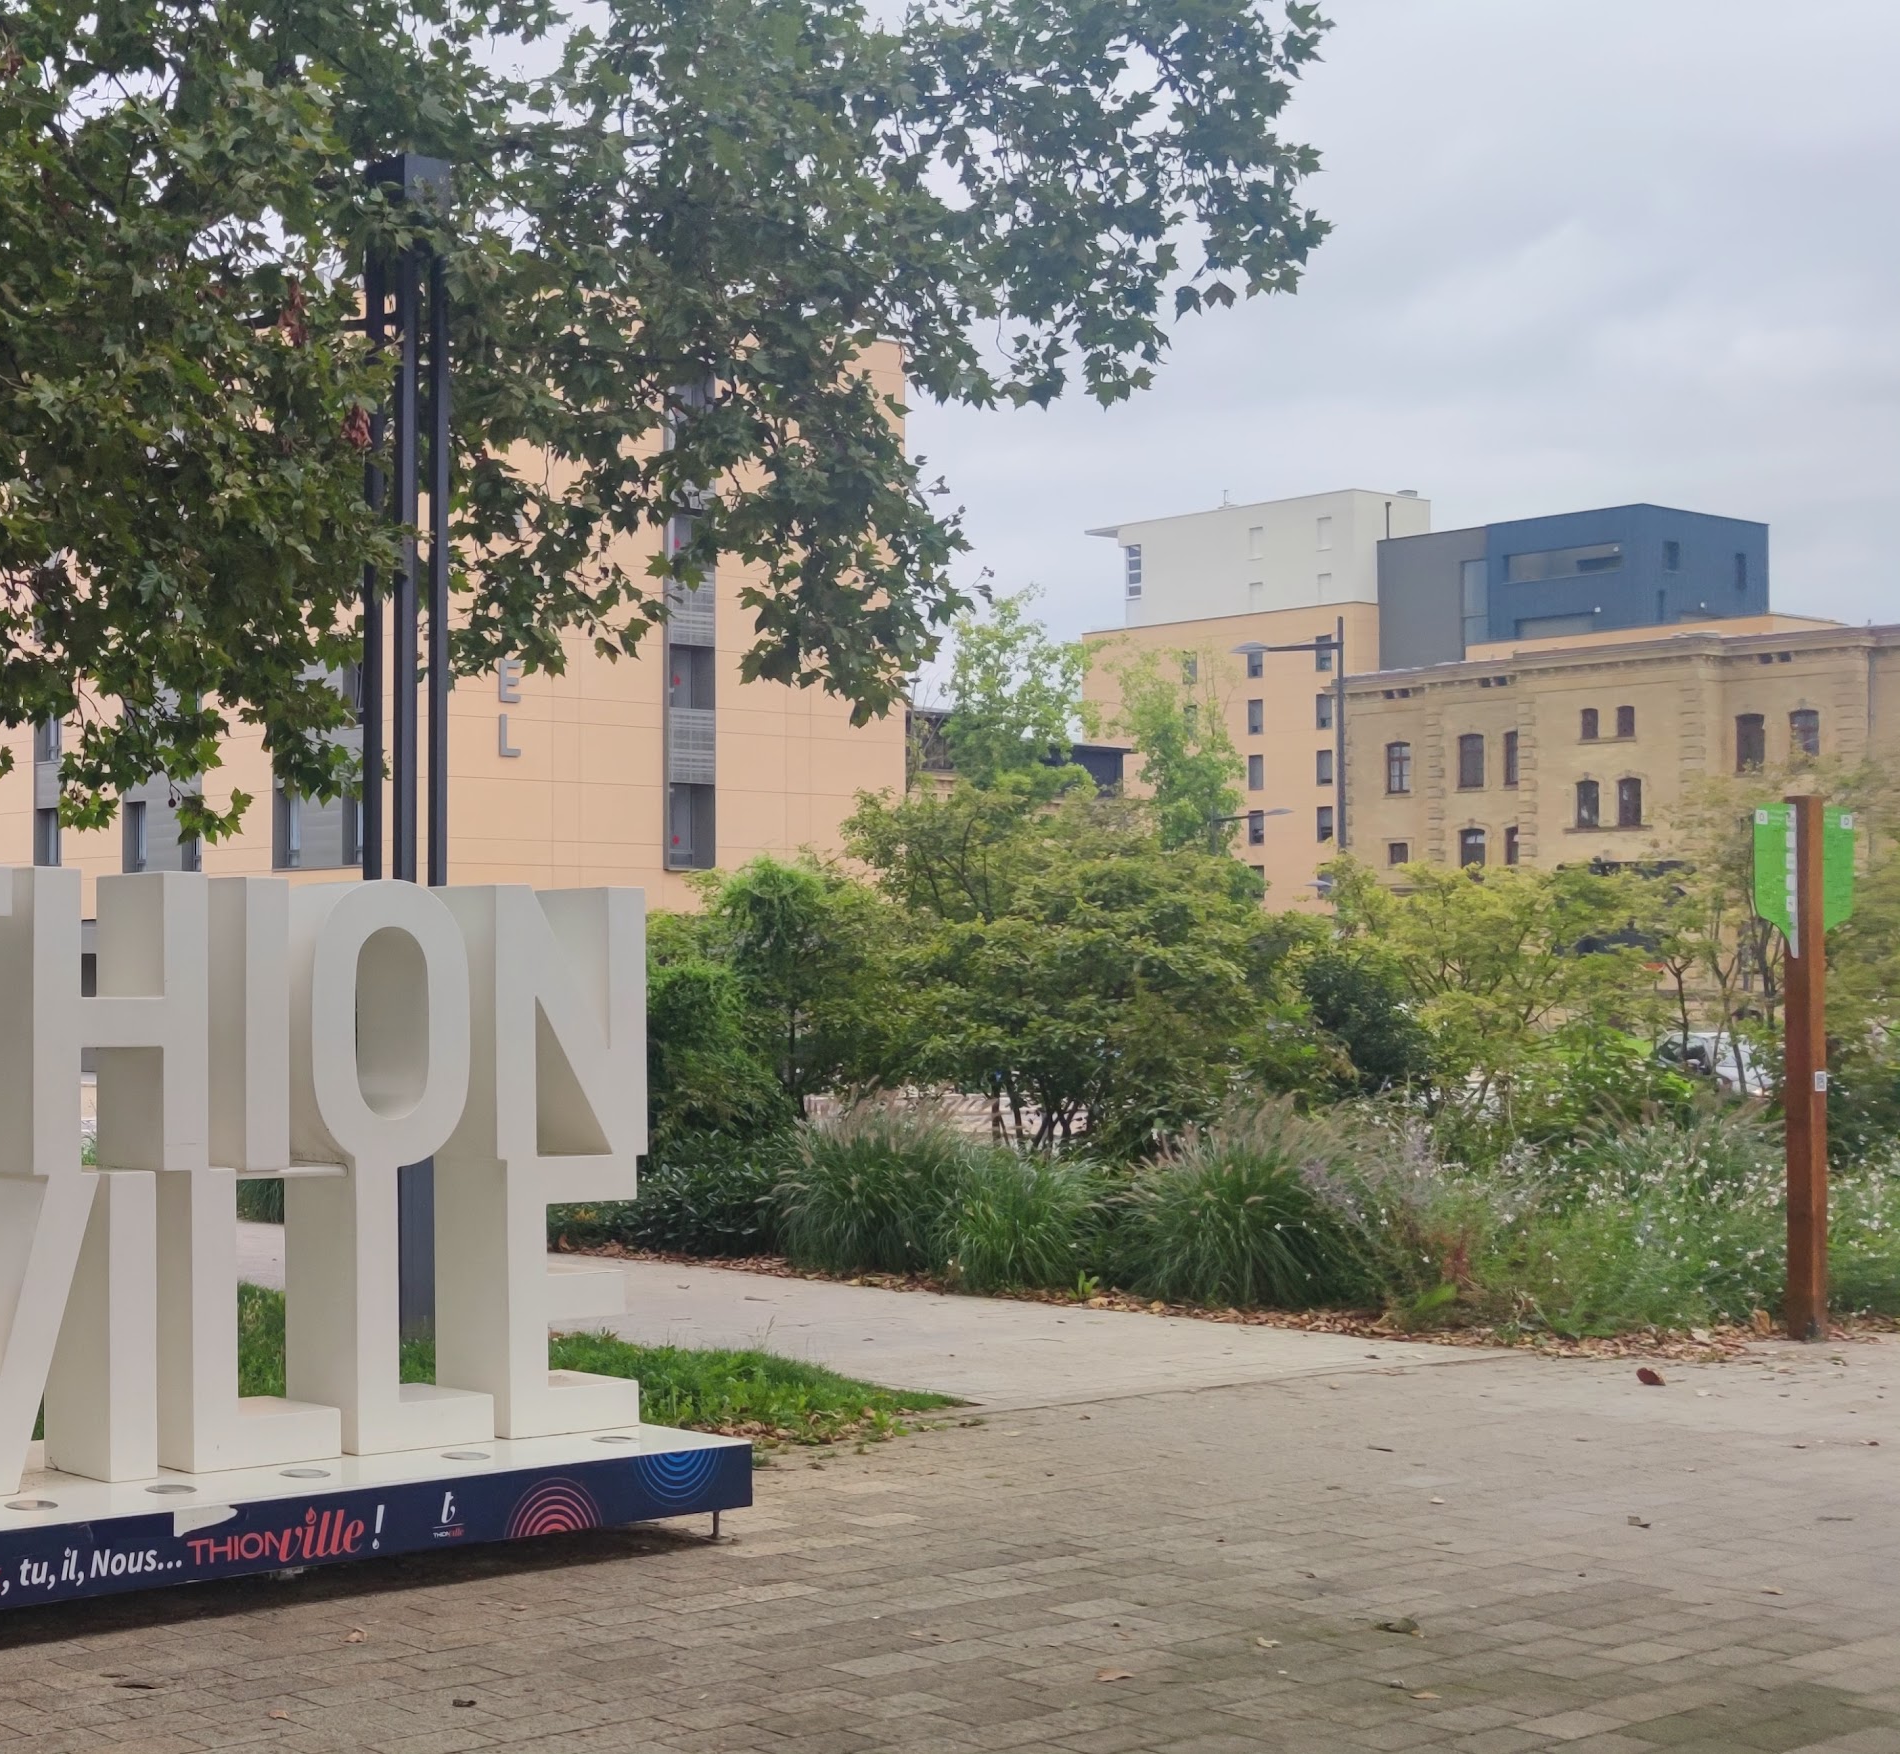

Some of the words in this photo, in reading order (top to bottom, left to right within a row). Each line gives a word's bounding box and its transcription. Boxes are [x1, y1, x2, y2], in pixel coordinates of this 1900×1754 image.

[19, 1557, 57, 1590] tu,
[60, 1546, 85, 1586] il,
[90, 1548, 183, 1579] Nous...
